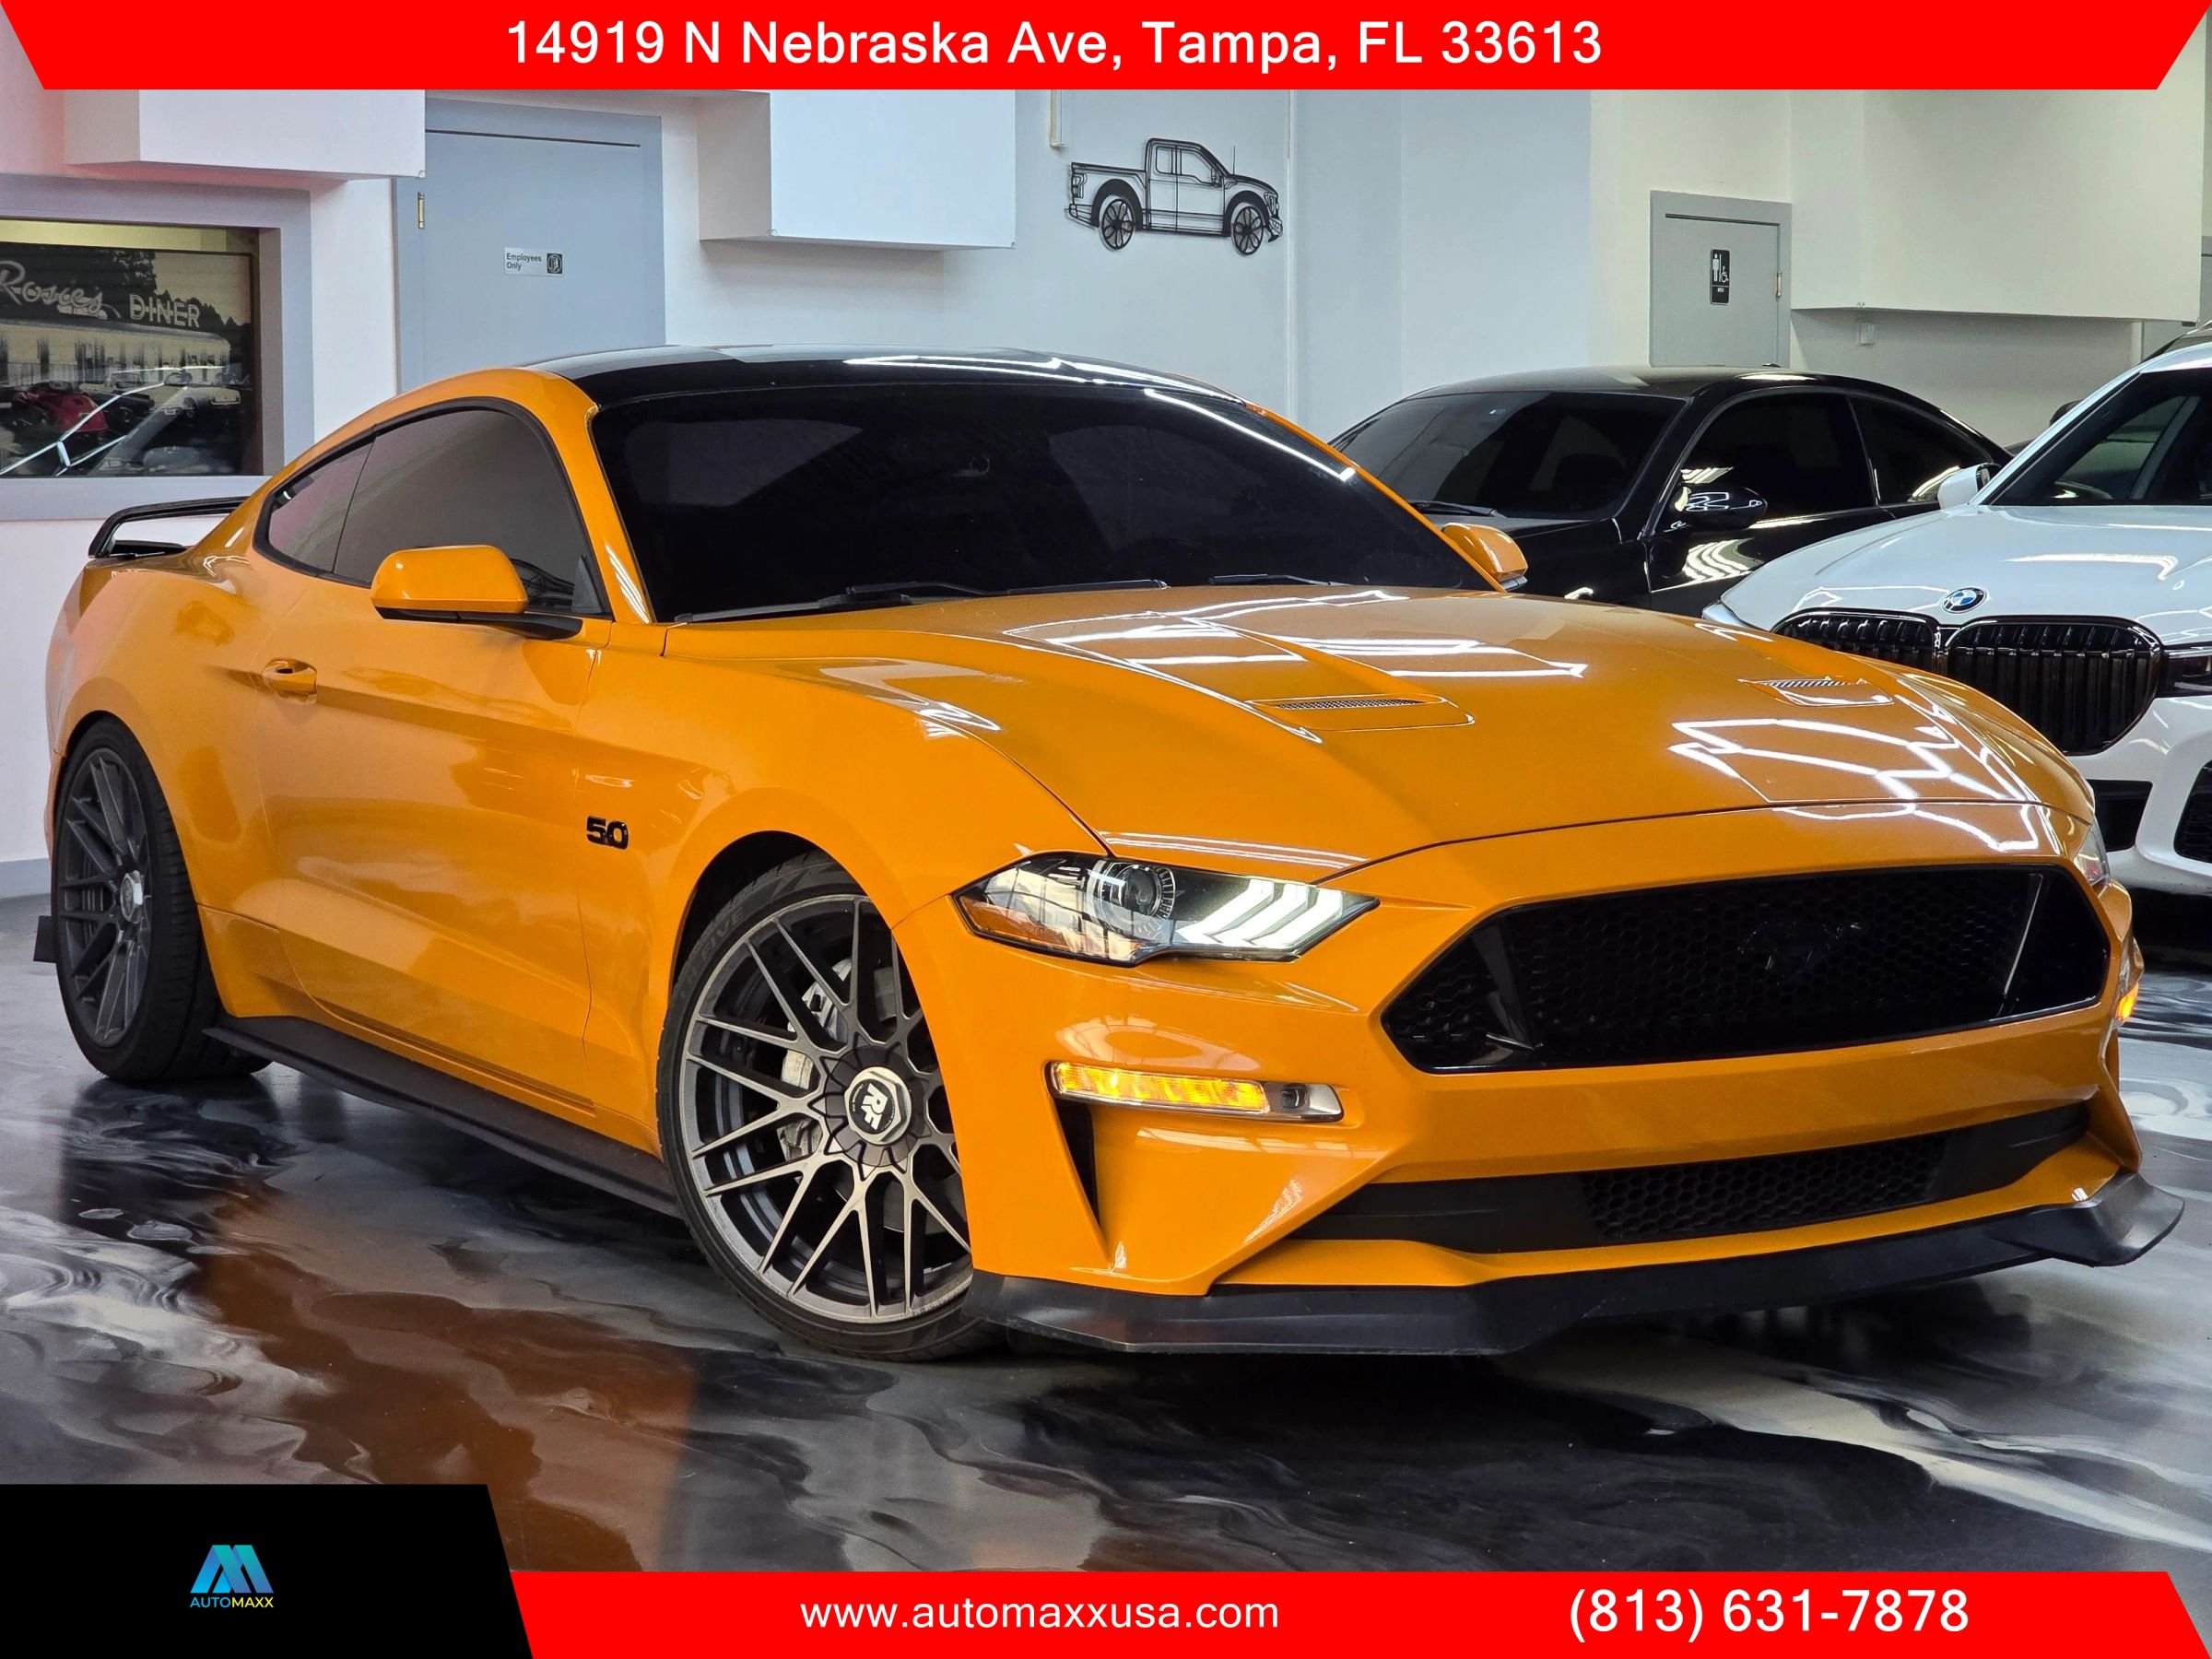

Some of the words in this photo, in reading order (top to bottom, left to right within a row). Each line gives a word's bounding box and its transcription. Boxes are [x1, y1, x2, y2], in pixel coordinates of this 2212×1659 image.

[506, 253, 542, 263] Employees
[506, 262, 523, 271] Only
[130, 294, 200, 328] DINER
